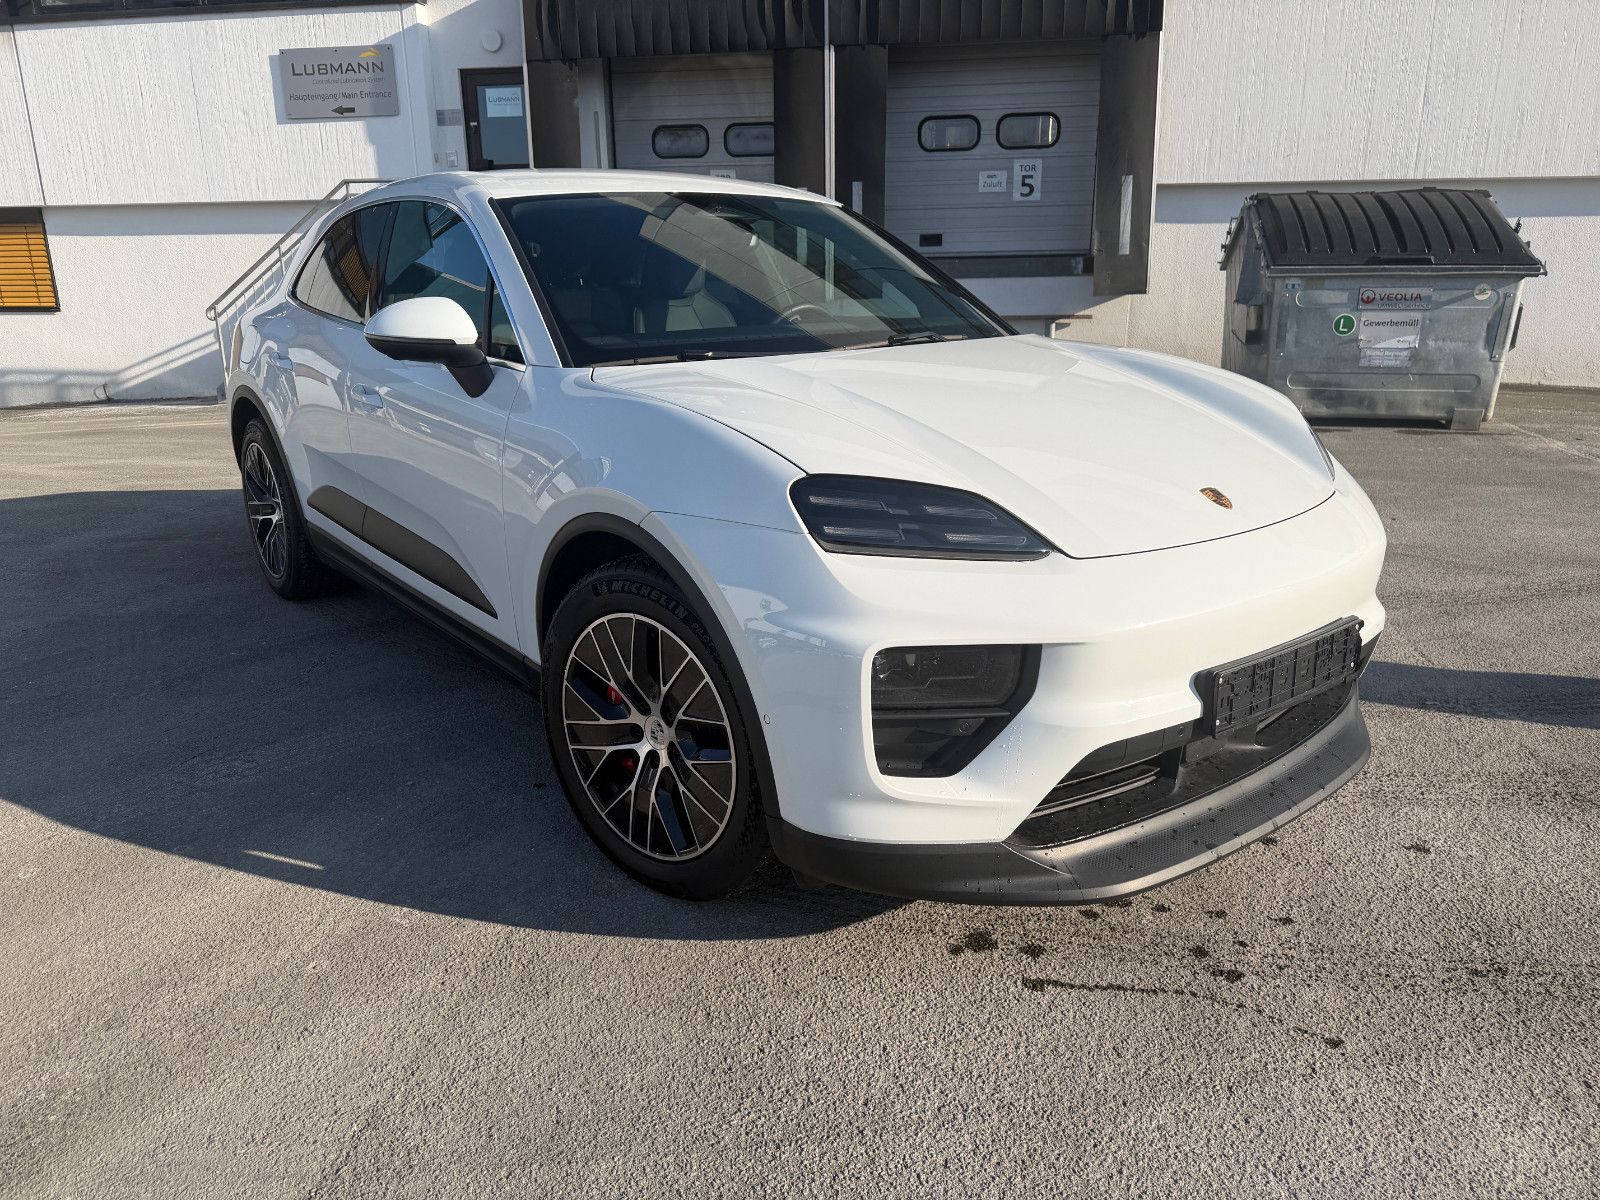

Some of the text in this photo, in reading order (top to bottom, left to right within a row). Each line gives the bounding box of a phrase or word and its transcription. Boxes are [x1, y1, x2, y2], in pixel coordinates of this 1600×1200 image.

[291, 61, 385, 77] LUBMANN
[360, 90, 392, 99] Entrance
[1019, 164, 1037, 172] TOR
[1020, 174, 1035, 198] 5
[1378, 292, 1422, 301] VEOLIA
[1339, 318, 1348, 332] L
[1363, 318, 1419, 327] Gewerbemüll
[612, 580, 689, 619] MICHELIN
